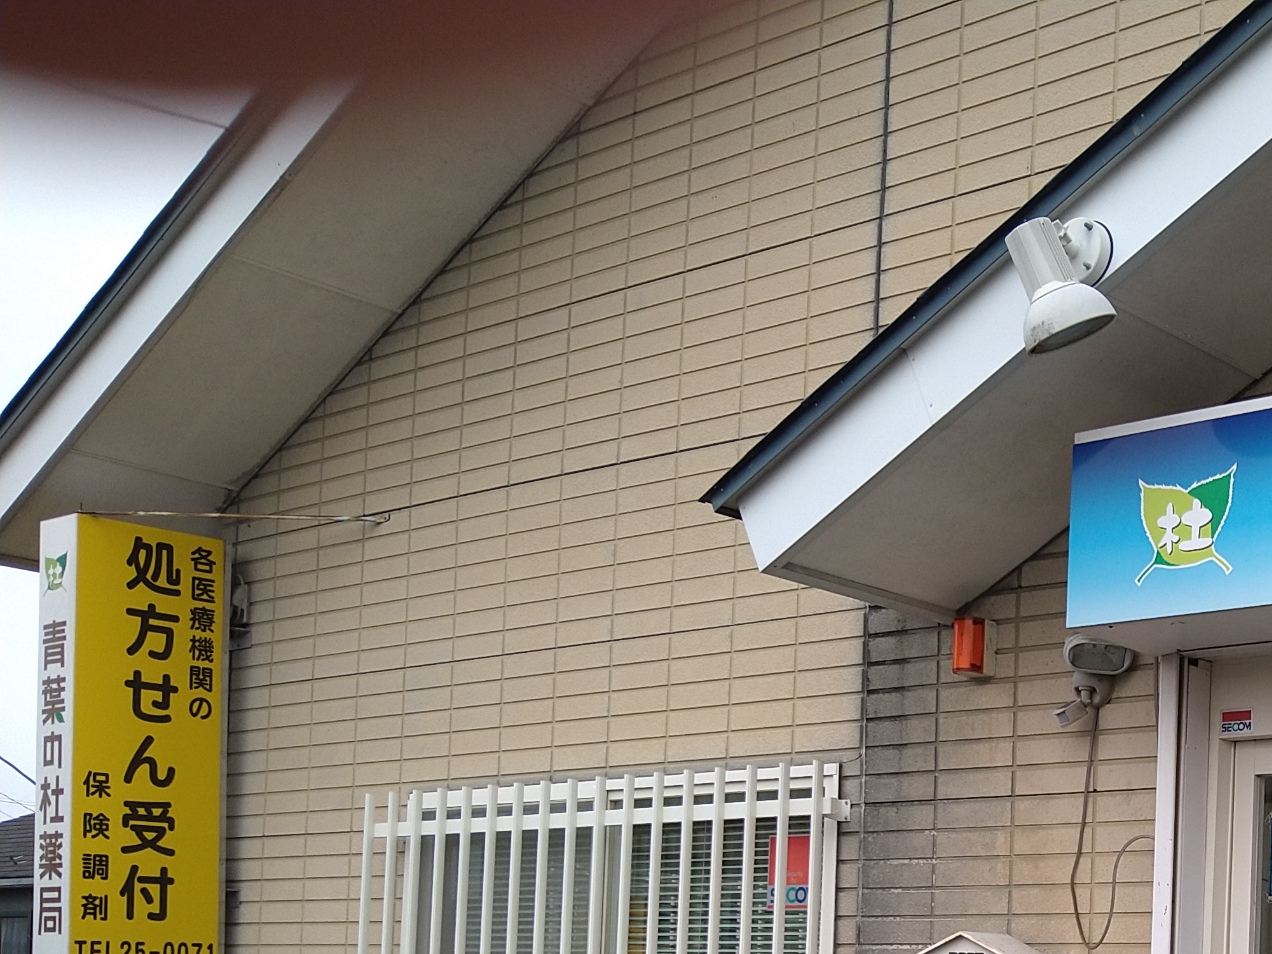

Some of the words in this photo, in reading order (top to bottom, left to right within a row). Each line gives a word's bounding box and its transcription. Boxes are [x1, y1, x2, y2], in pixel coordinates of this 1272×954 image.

[1157, 498, 1214, 555] 杜
[189, 547, 216, 720] 各医療機関の
[37, 620, 67, 936] 青葉の杜薬局
[119, 537, 181, 922] 処方せん受付
[1222, 722, 1251, 732] SECOM
[81, 770, 111, 922] 保険調剤
